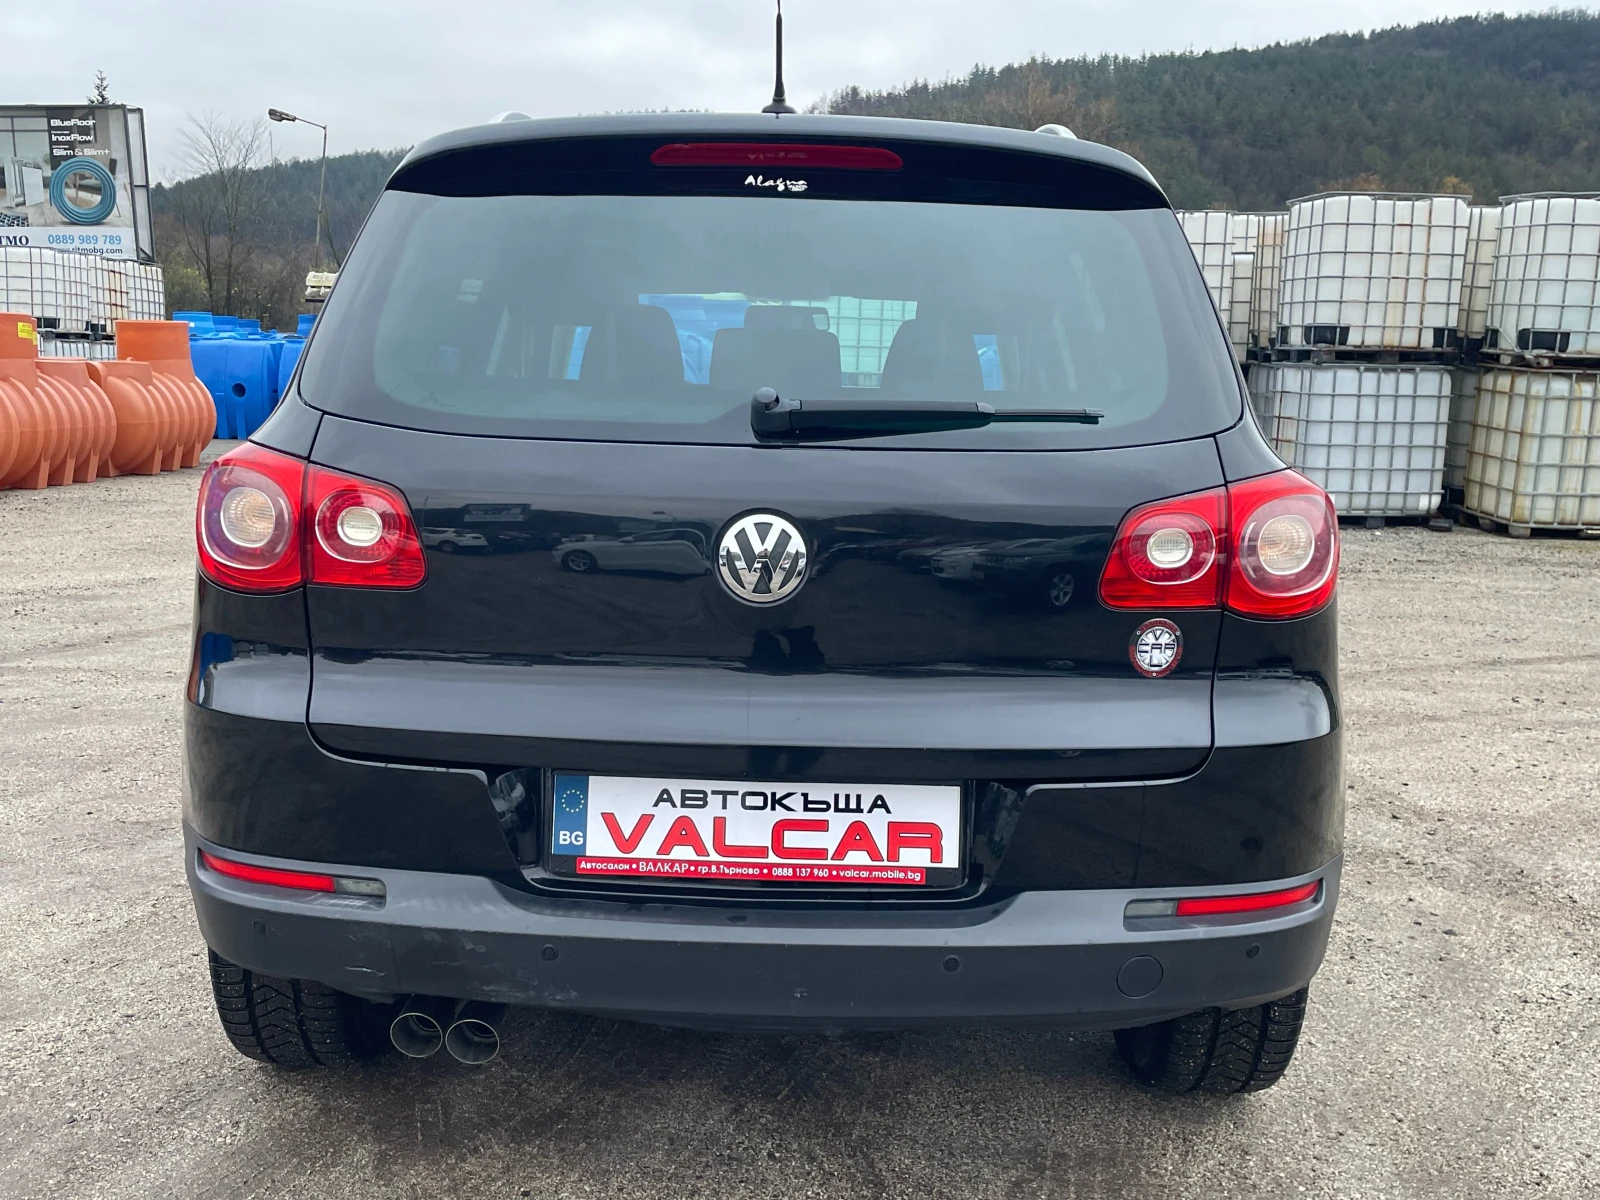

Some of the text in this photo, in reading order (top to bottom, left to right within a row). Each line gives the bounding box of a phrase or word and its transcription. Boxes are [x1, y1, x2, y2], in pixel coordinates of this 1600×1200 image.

[48, 234, 122, 244] 0889 989 789
[652, 788, 892, 814] АВТОКЪЩА
[559, 831, 584, 845] BG
[600, 812, 944, 864] VALCAR
[580, 860, 630, 871] Автосалон
[638, 861, 689, 874] ВАЛКАР
[772, 867, 794, 877] 0888
[796, 868, 812, 877] 137
[813, 868, 829, 878] 960
[839, 870, 921, 882] valcar.mobile.bg
